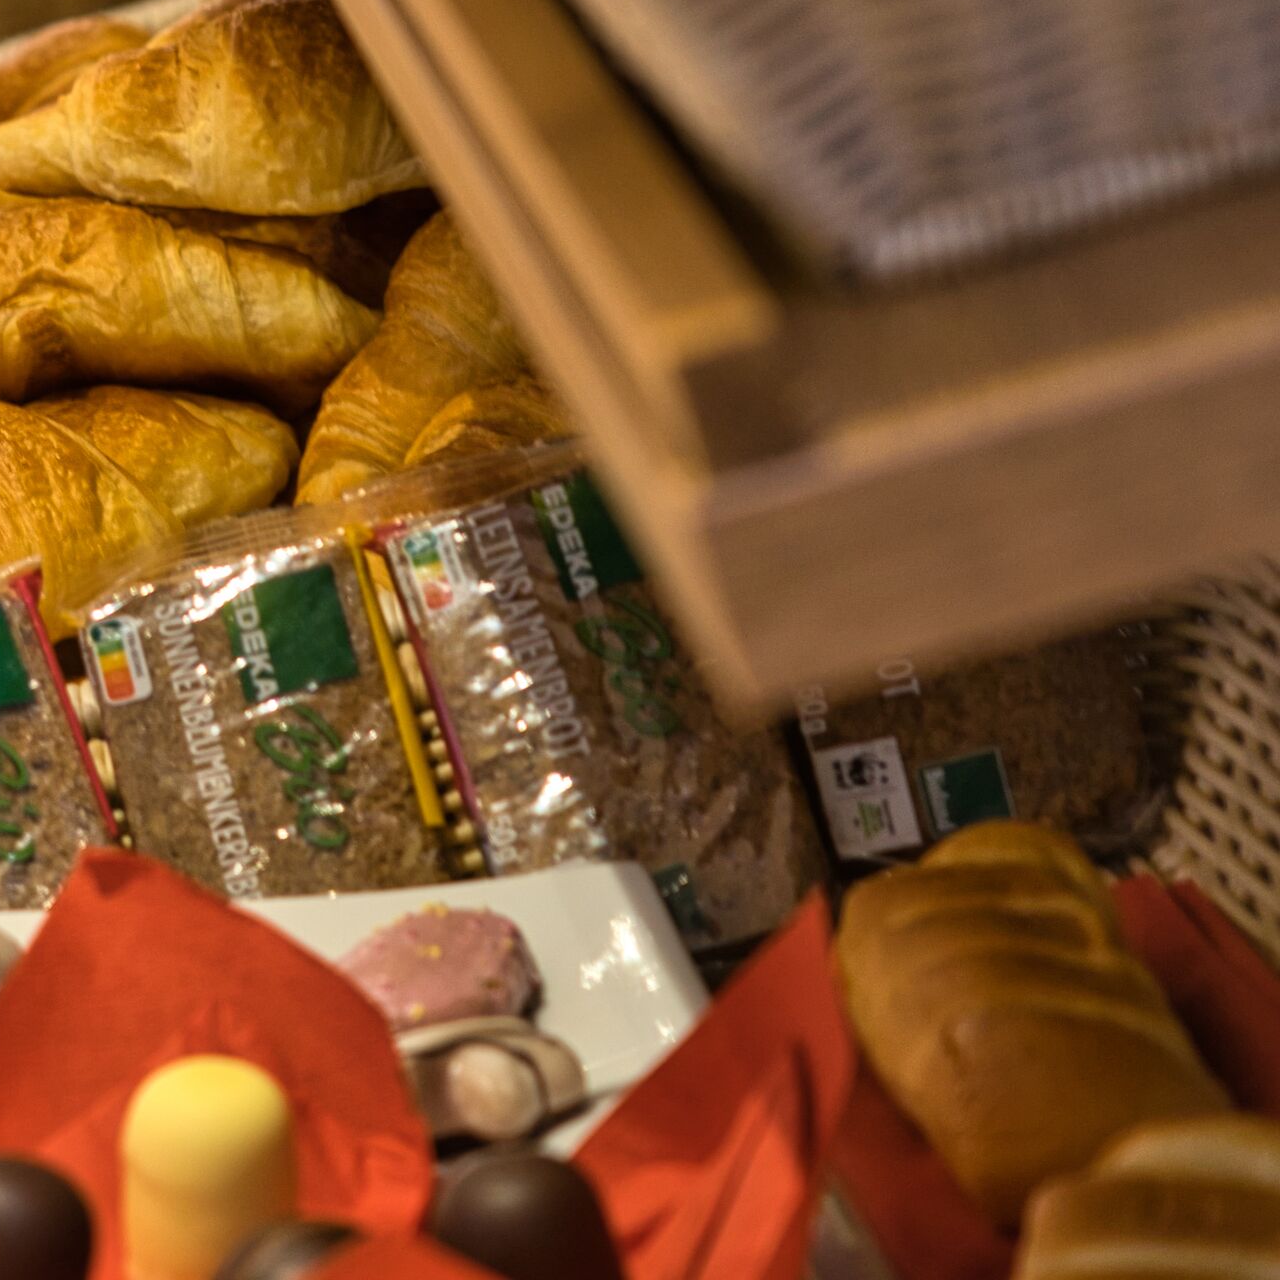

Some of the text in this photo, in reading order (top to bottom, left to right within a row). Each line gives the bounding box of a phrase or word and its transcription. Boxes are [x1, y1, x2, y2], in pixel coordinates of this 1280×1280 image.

[541, 484, 599, 600] EDEKA
[232, 586, 280, 702] EDEKA
[466, 502, 591, 759] LEINSAMENBROT
[254, 705, 353, 850] Bio
